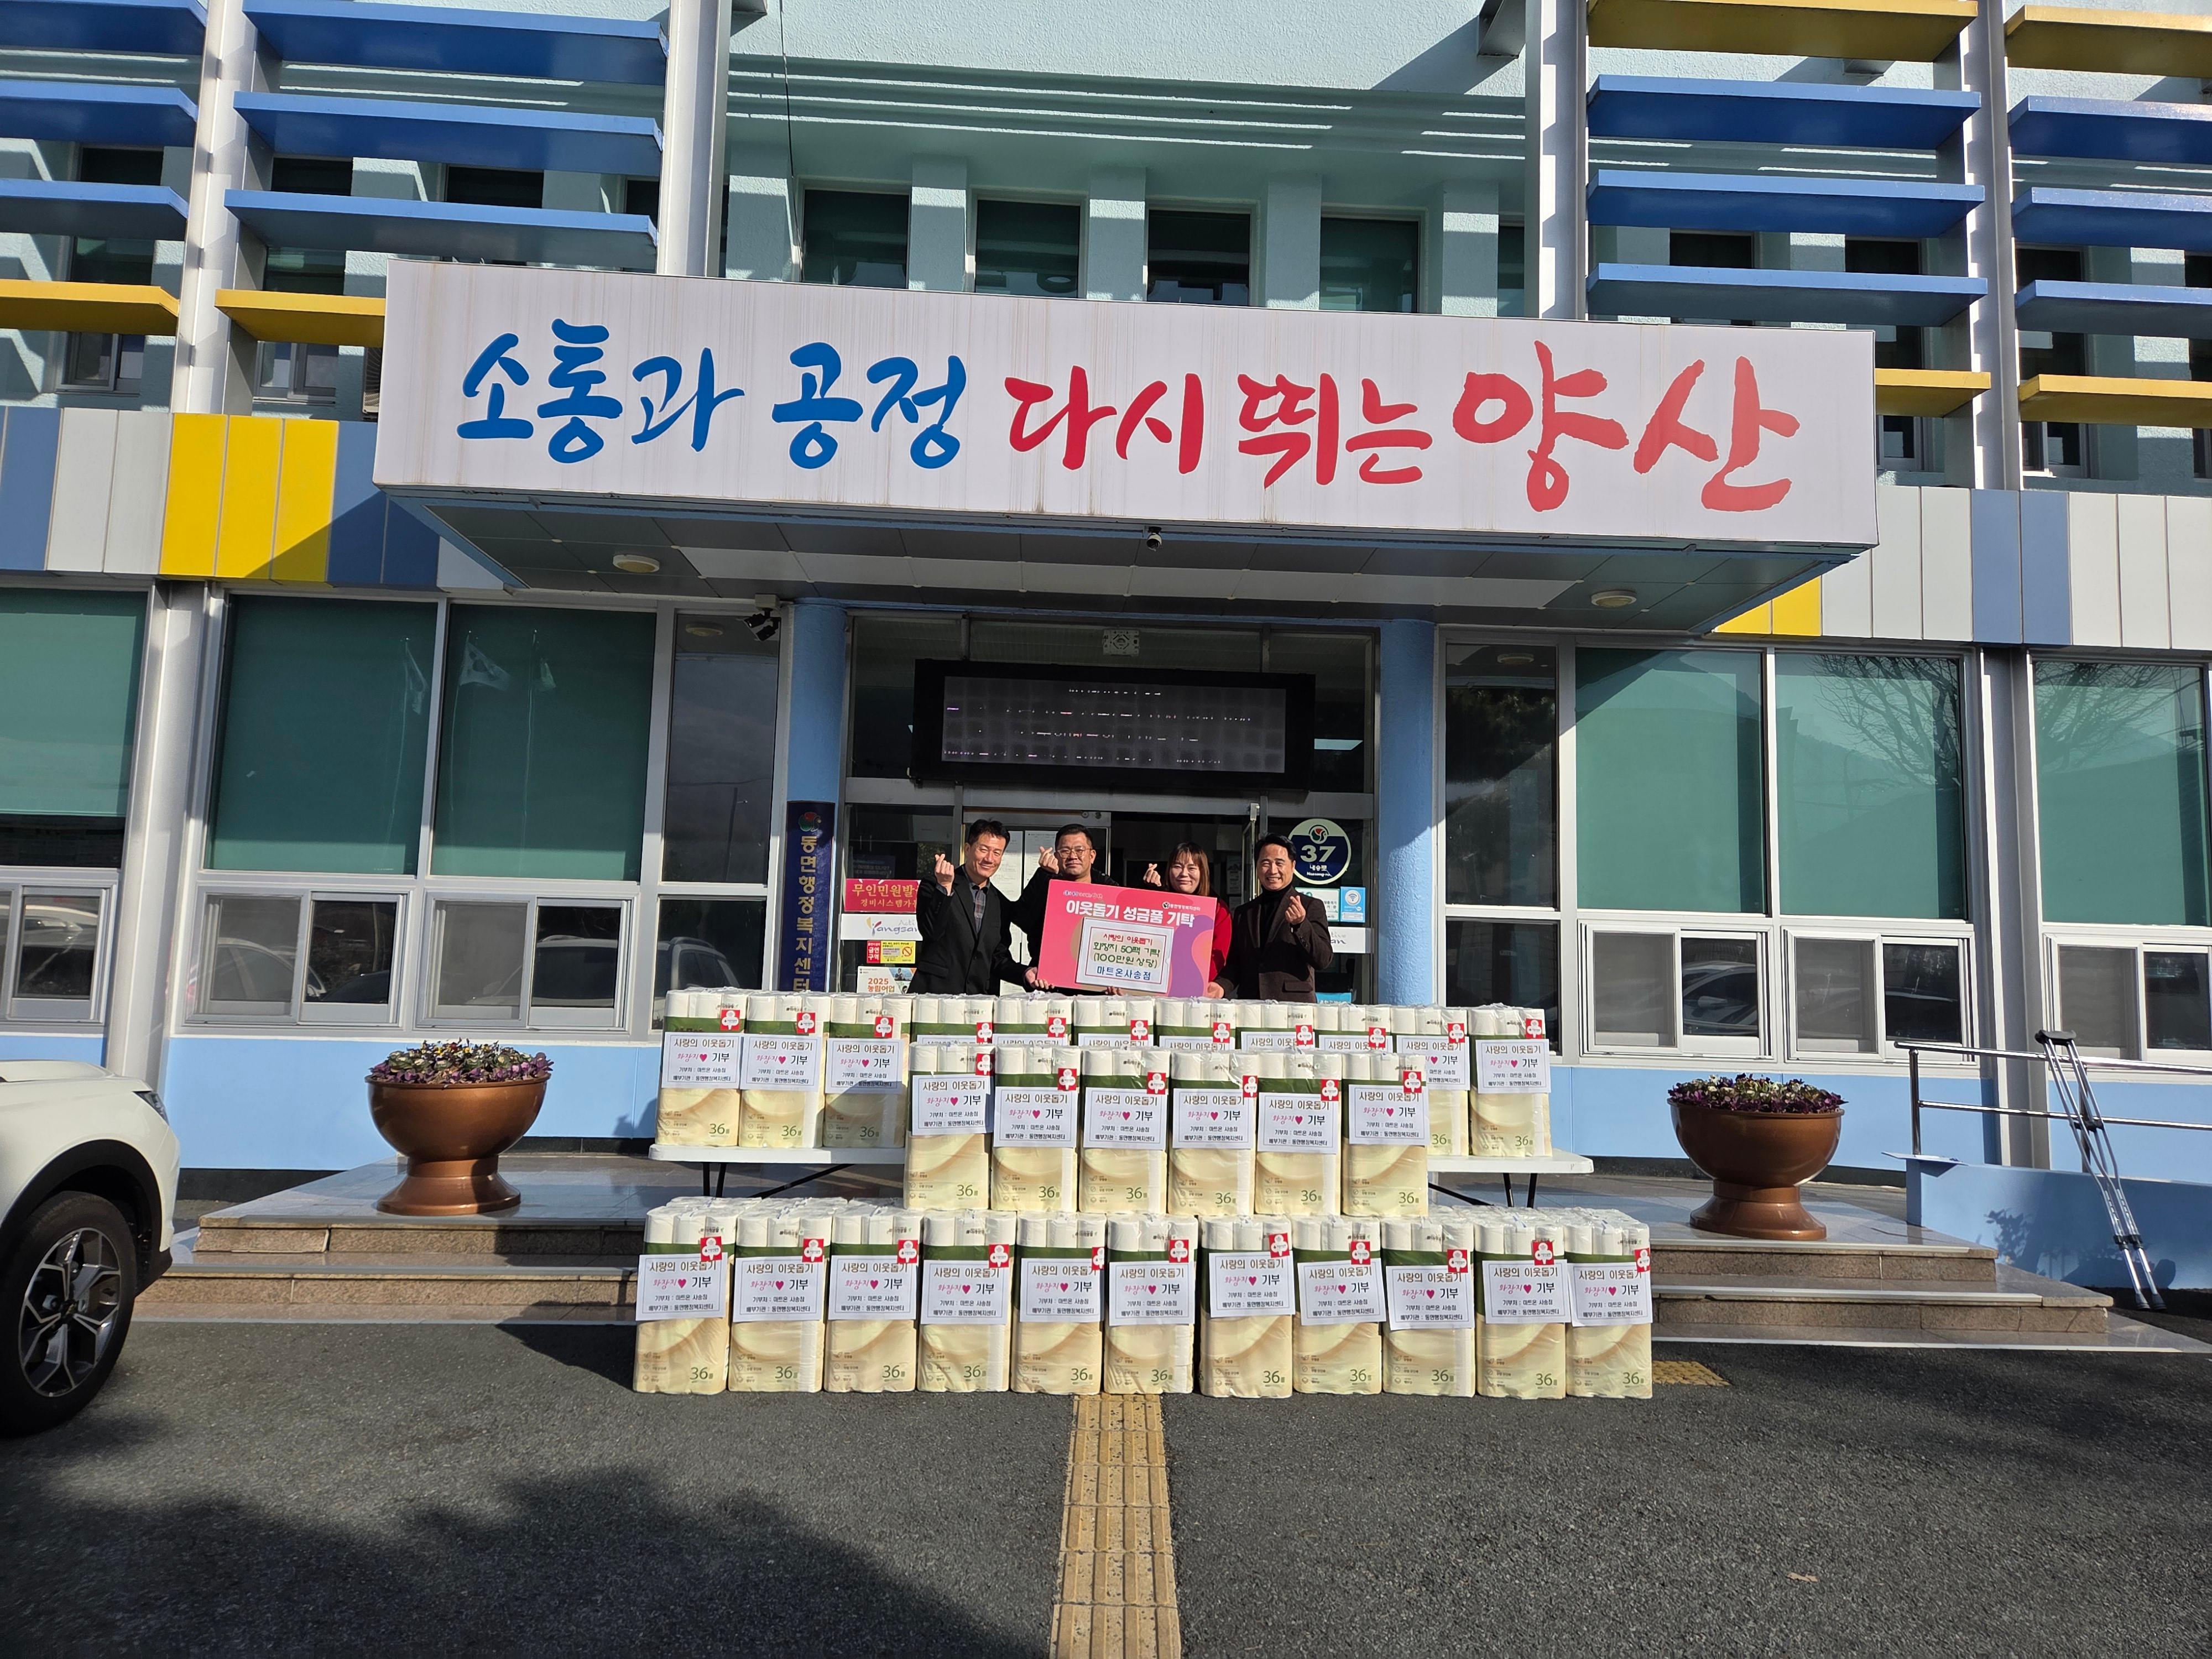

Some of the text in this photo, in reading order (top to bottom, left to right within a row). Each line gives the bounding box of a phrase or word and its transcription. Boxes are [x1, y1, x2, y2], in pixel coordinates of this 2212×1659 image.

[457, 319, 1798, 512] 소통과 공정 다시 뛰는 양산
[1301, 845, 1336, 862] 37
[852, 884, 920, 898] 무인민원발
[793, 836, 817, 992] 동면행정복지센터
[1066, 900, 1194, 927] 이웃돕기 성금품 기탁
[1103, 933, 1152, 946] 사랑의 이웃돕기
[1093, 942, 1160, 957] 화장지 50팩 기탁
[1094, 953, 1157, 968] (100만원 상당)
[1097, 966, 1151, 980] 마트온사송점
[674, 1039, 734, 1048] 사랑의 이웃돕기
[753, 1040, 812, 1051] 사랑의 이웃돕기
[1251, 1037, 1297, 1046] 사랑의 이웃
[1329, 1041, 1380, 1050] 사랑의 이웃
[1406, 1042, 1461, 1051] 사랑의 이웃돕기
[1485, 1046, 1507, 1054] 사랑의
[677, 1053, 729, 1062] 화장지 기부
[756, 1055, 807, 1065] 화장지 기부
[1442, 1056, 1458, 1065] 기부
[1490, 1058, 1538, 1068] 화장지 기부
[839, 1059, 891, 1068] 화장지 기부
[922, 1081, 985, 1091] 사랑의 이웃돕기
[927, 1095, 981, 1107] 화장지 기부
[1005, 1094, 1067, 1103] 사랑의 이웃돕기
[1095, 1094, 1157, 1105] 사랑의 이웃돕기
[1183, 1095, 1244, 1105] 사랑의 이웃돕기
[1359, 1092, 1419, 1102] 사랑의 이웃돕기
[1269, 1099, 1329, 1110] 사랑의 이웃돕기
[1009, 1109, 1063, 1119] 화장지 기부
[1099, 1110, 1152, 1121] 화장지 기부
[1187, 1111, 1240, 1121] 화장지 기부
[1363, 1107, 1416, 1117] 화장지 기부
[1272, 1115, 1325, 1125] 화장지 기부
[649, 1261, 716, 1272] 사랑의 이웃돕기
[747, 1263, 813, 1274] 사랑의 이웃돕기
[842, 1263, 907, 1272] 사랑의 이웃돕기
[1219, 1259, 1284, 1270] 사랑의 이웃돕기
[934, 1267, 999, 1277] 사랑의 이웃돕기
[1032, 1266, 1095, 1276] 사랑의 이웃돕기
[1120, 1269, 1184, 1278] 사랑의 이웃돕기
[1308, 1266, 1372, 1279] 사랑의 이웃돕기
[1493, 1267, 1558, 1277] 사랑의 이웃돕기
[1579, 1270, 1642, 1280] 사랑의 이웃돕기
[1224, 1274, 1280, 1287] 화장지 기부
[1396, 1273, 1462, 1282] 사랑의 이웃돕기
[653, 1277, 711, 1290] 화장지 기부
[750, 1279, 808, 1291] 화장지 기부
[846, 1279, 902, 1290] 화장지 기부
[1036, 1282, 1091, 1293] 화장지 기부
[1314, 1282, 1370, 1296] 화장지 기부
[1499, 1283, 1555, 1295] 화장지 기부
[938, 1284, 994, 1295] 화장지 기부
[1124, 1284, 1180, 1295] 화장지 기부
[1402, 1288, 1459, 1300] 화장지 기부
[1584, 1285, 1640, 1297] 화장지 기부
